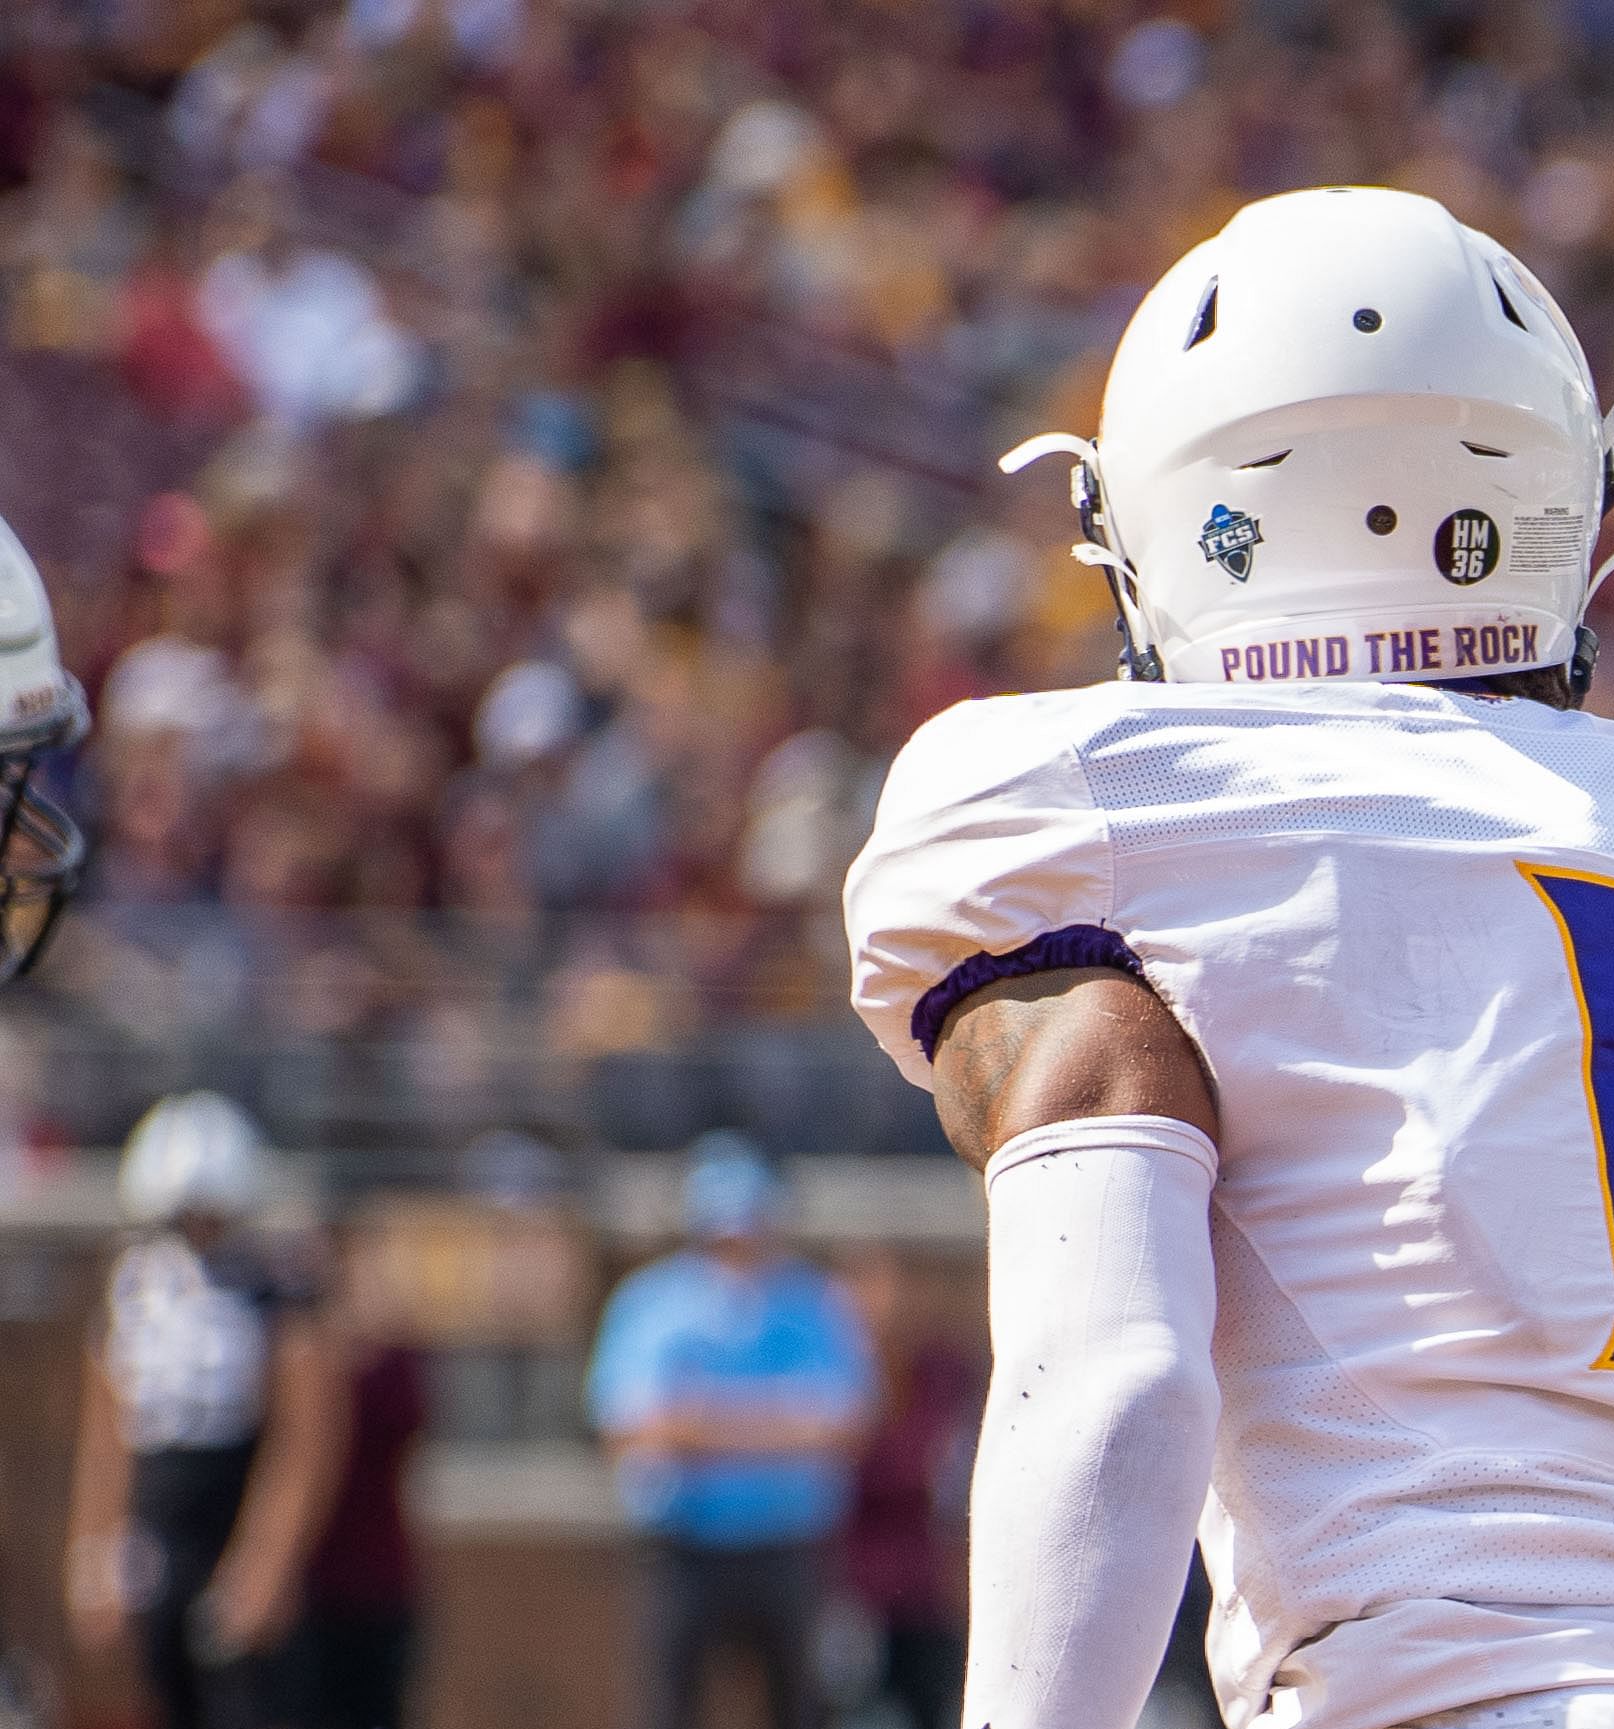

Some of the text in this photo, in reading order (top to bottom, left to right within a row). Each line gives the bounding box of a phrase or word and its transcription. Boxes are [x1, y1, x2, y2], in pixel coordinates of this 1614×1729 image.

[1205, 525, 1254, 555] FCS
[1451, 519, 1489, 549] HM
[1451, 550, 1485, 578] 36
[1220, 624, 1539, 682] POUND THE ROCK
